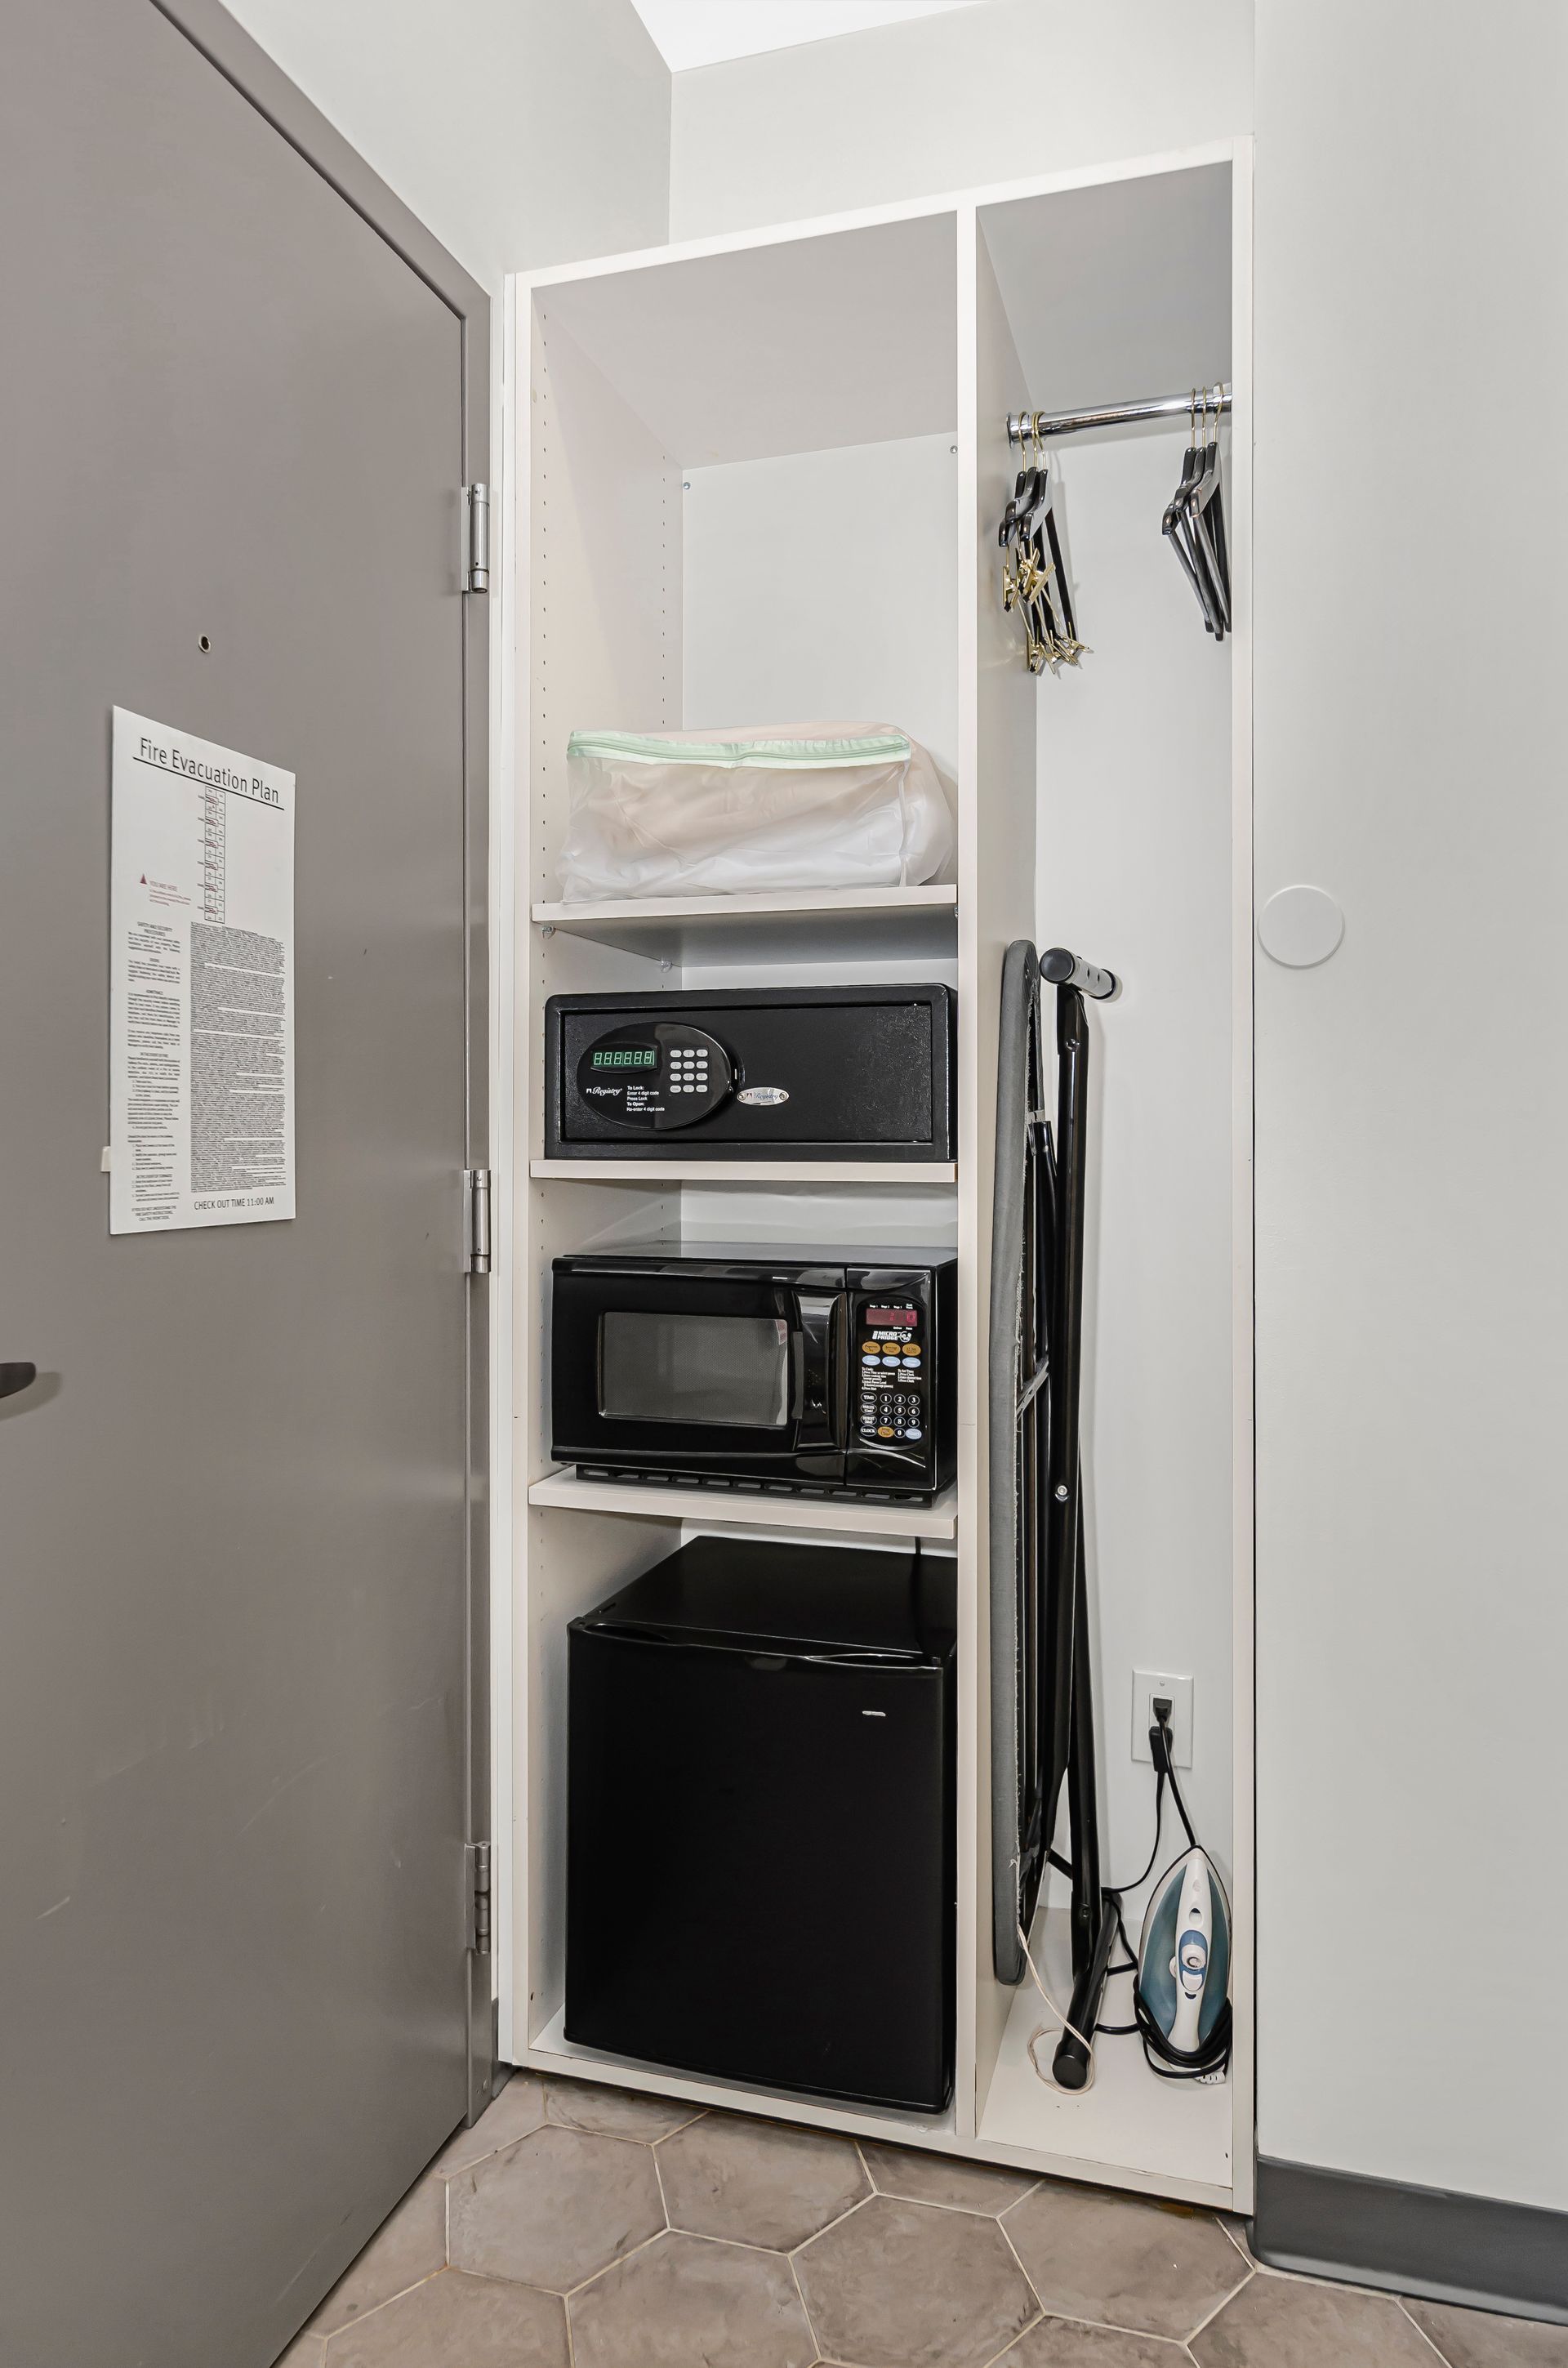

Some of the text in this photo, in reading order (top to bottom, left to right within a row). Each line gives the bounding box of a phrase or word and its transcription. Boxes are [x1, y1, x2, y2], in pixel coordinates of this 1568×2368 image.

[140, 737, 279, 804] Fire Evacuation Plan
[194, 1196, 274, 1210] CHECK OUT TIME 11:00 AM
